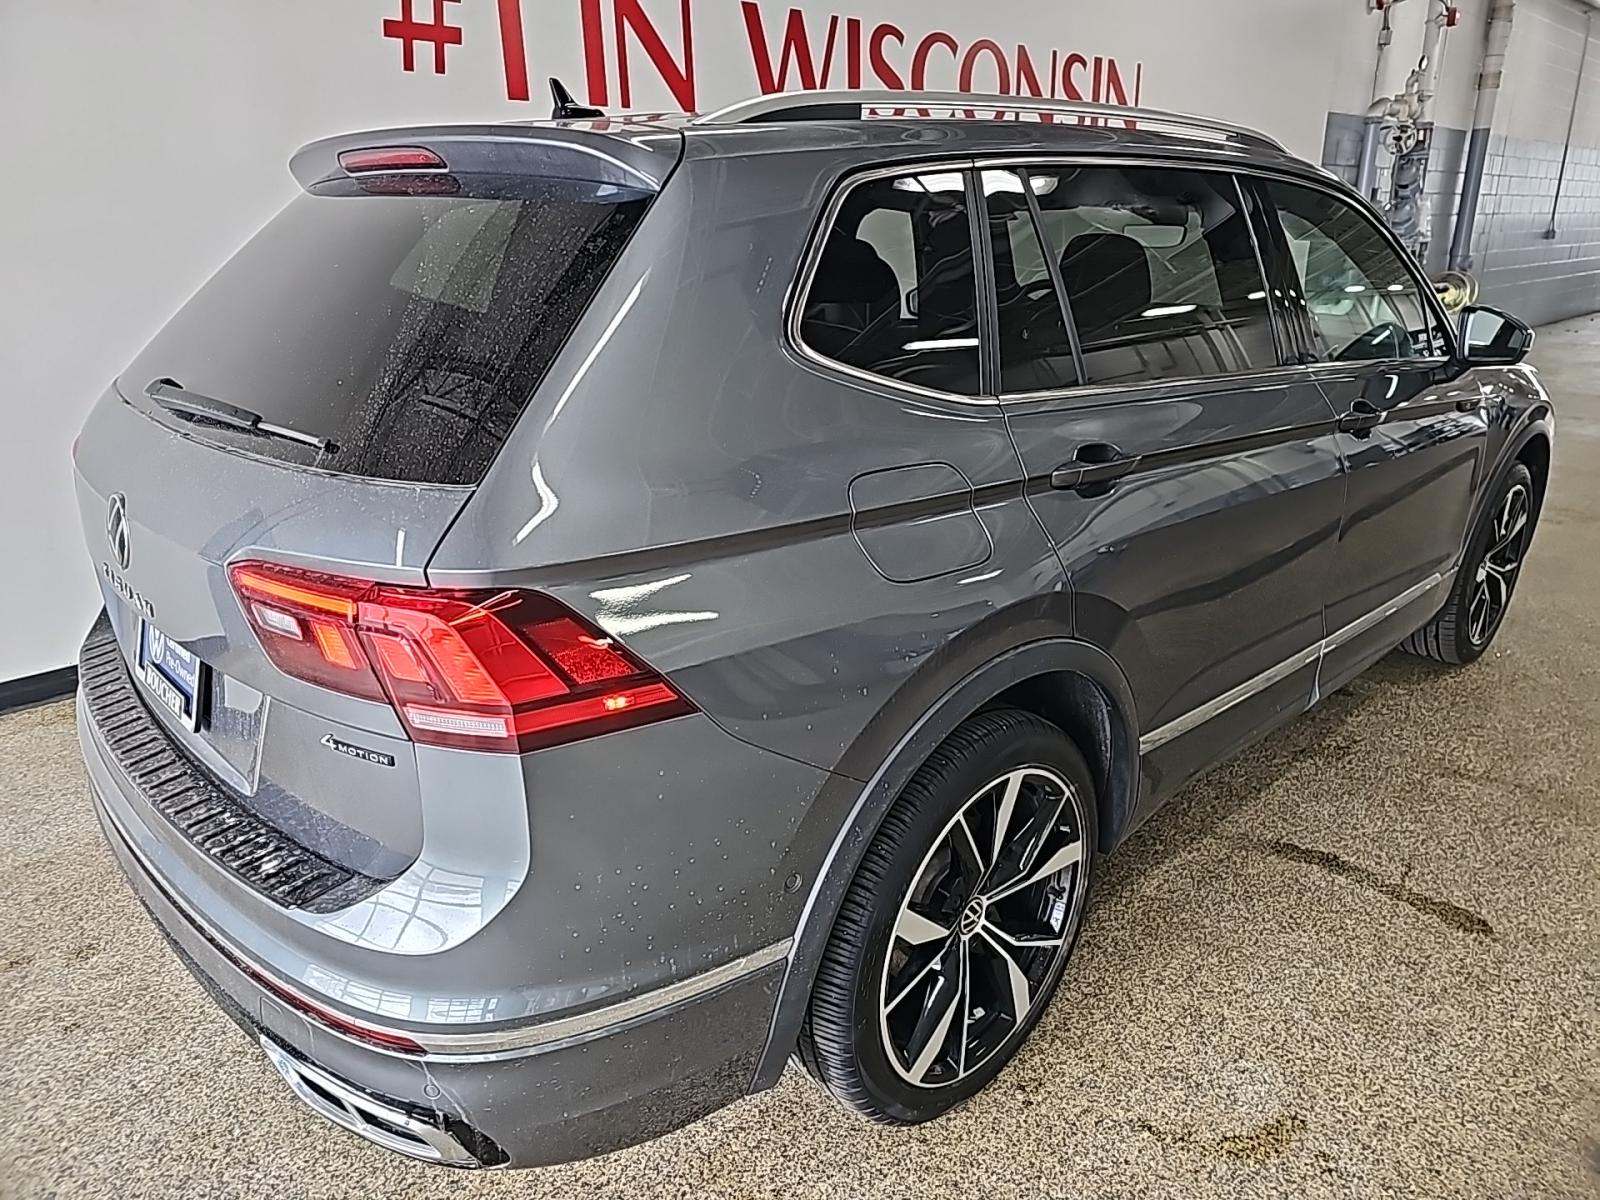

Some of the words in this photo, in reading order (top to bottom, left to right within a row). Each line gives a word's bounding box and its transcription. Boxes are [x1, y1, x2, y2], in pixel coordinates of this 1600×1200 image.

[740, 0, 1142, 130] WISCONSIN
[145, 667, 182, 716] BOUCHER
[320, 733, 389, 765] 4MOTION
